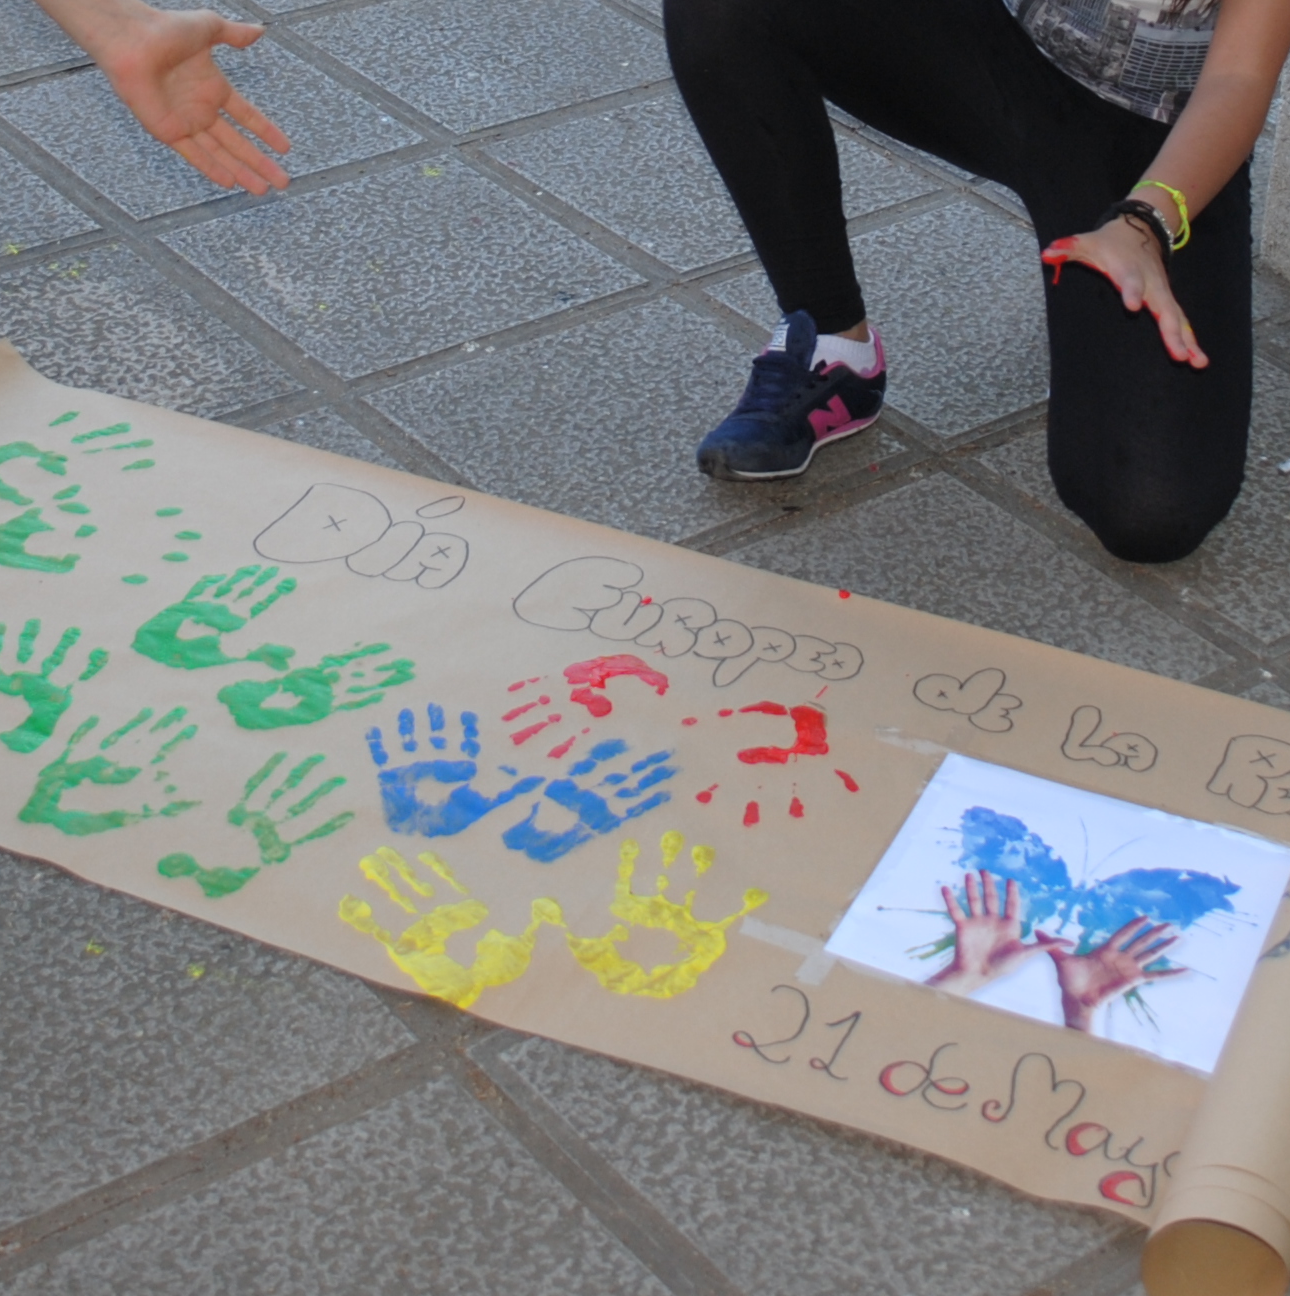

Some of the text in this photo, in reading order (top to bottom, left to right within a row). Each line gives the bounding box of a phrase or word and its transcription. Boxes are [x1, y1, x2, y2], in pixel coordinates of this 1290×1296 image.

[732, 984, 1181, 1209] 21 de May
